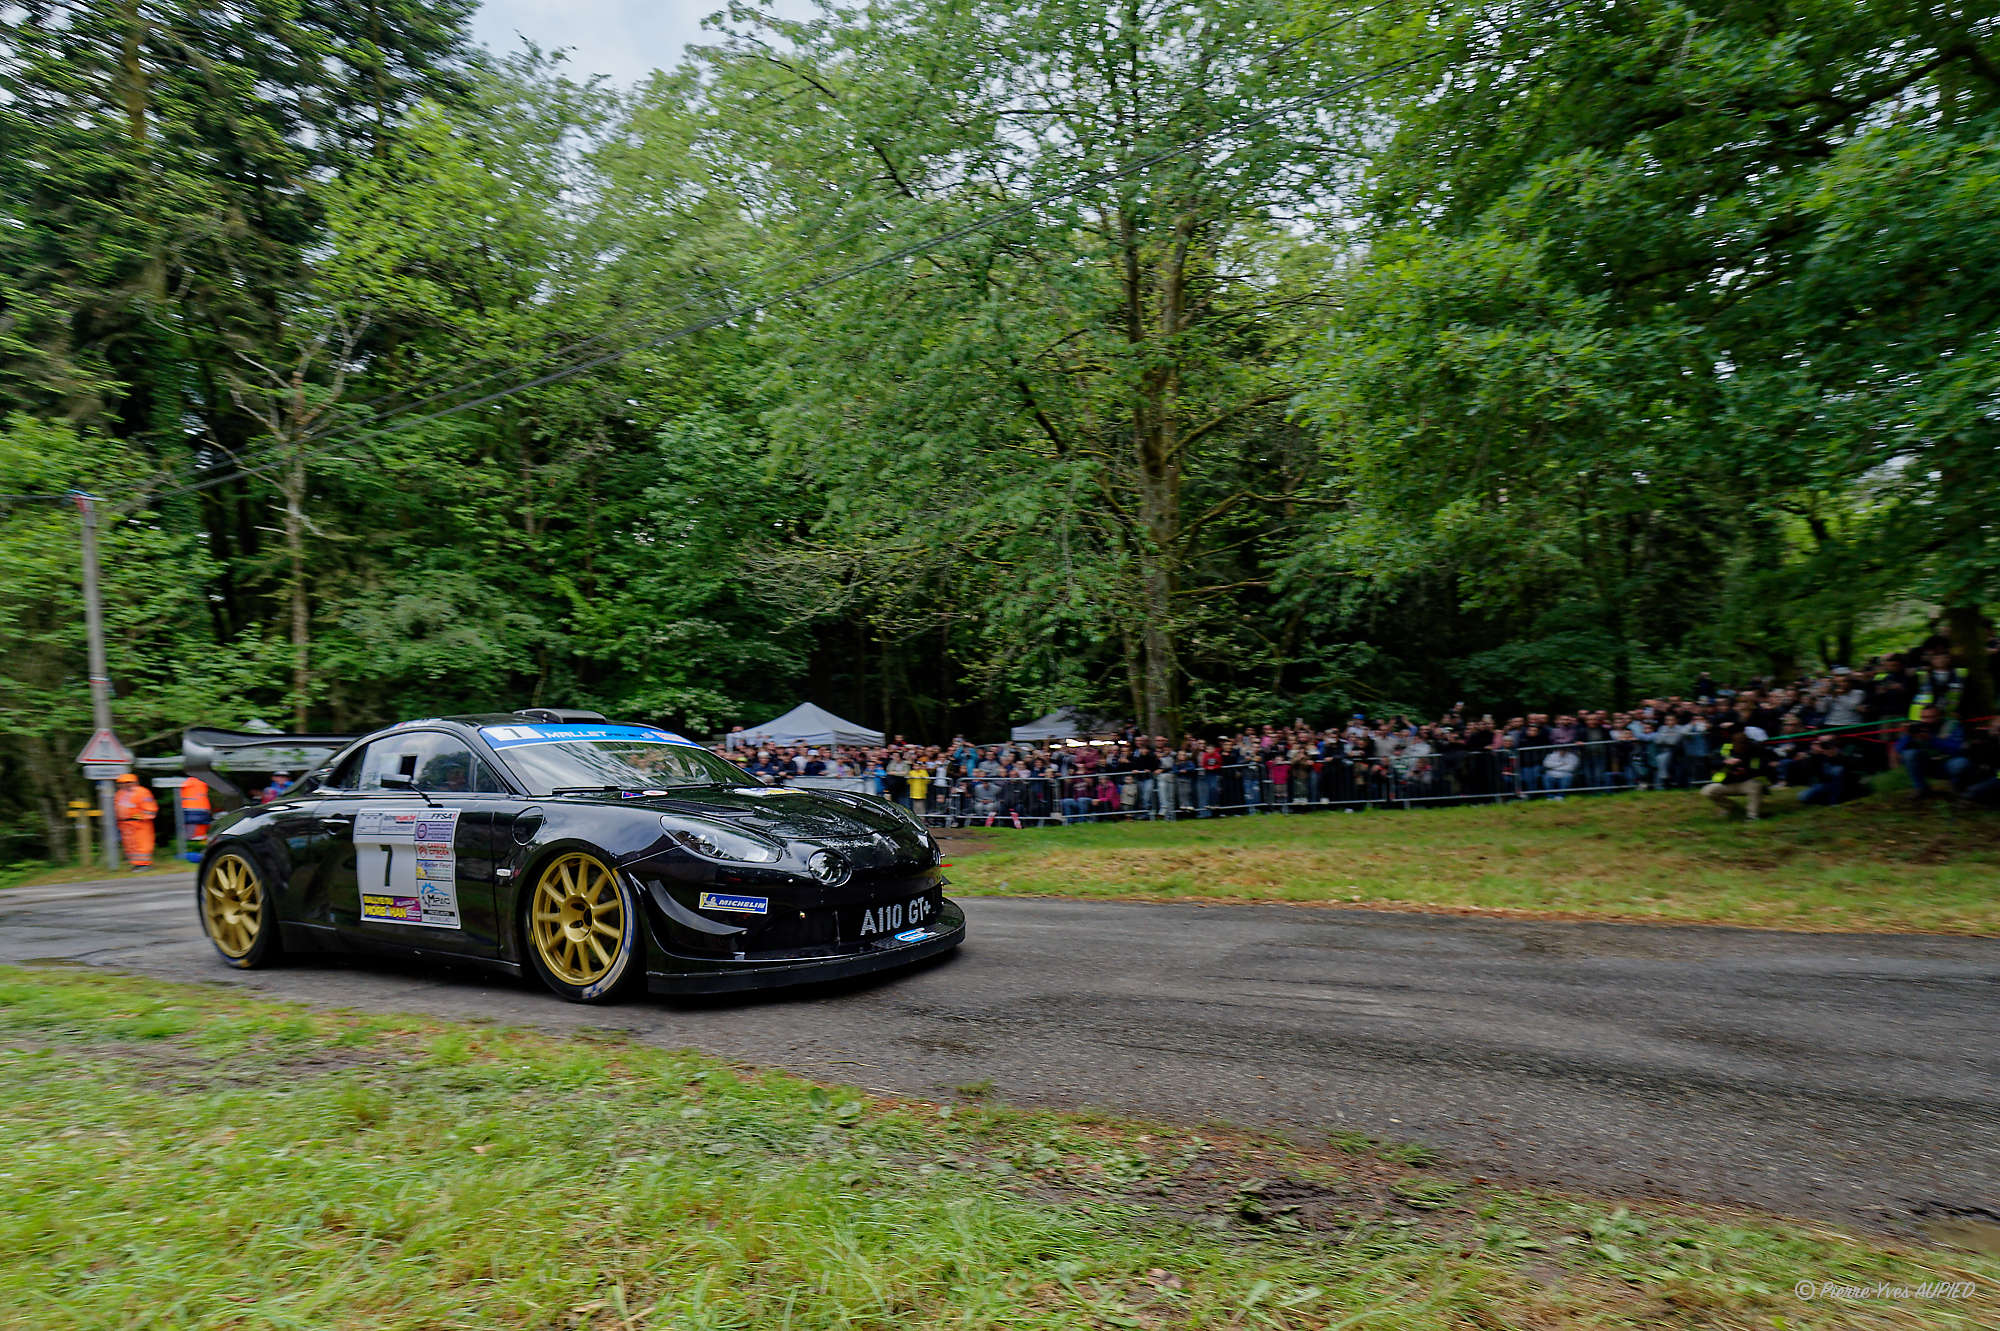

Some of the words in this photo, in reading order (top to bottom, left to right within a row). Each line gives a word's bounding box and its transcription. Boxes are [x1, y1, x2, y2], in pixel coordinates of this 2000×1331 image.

[545, 731, 608, 740] MALLET
[380, 845, 392, 887] 7
[718, 899, 766, 910] MICHELIN
[860, 903, 902, 936] A110
[908, 896, 931, 925] GT+
